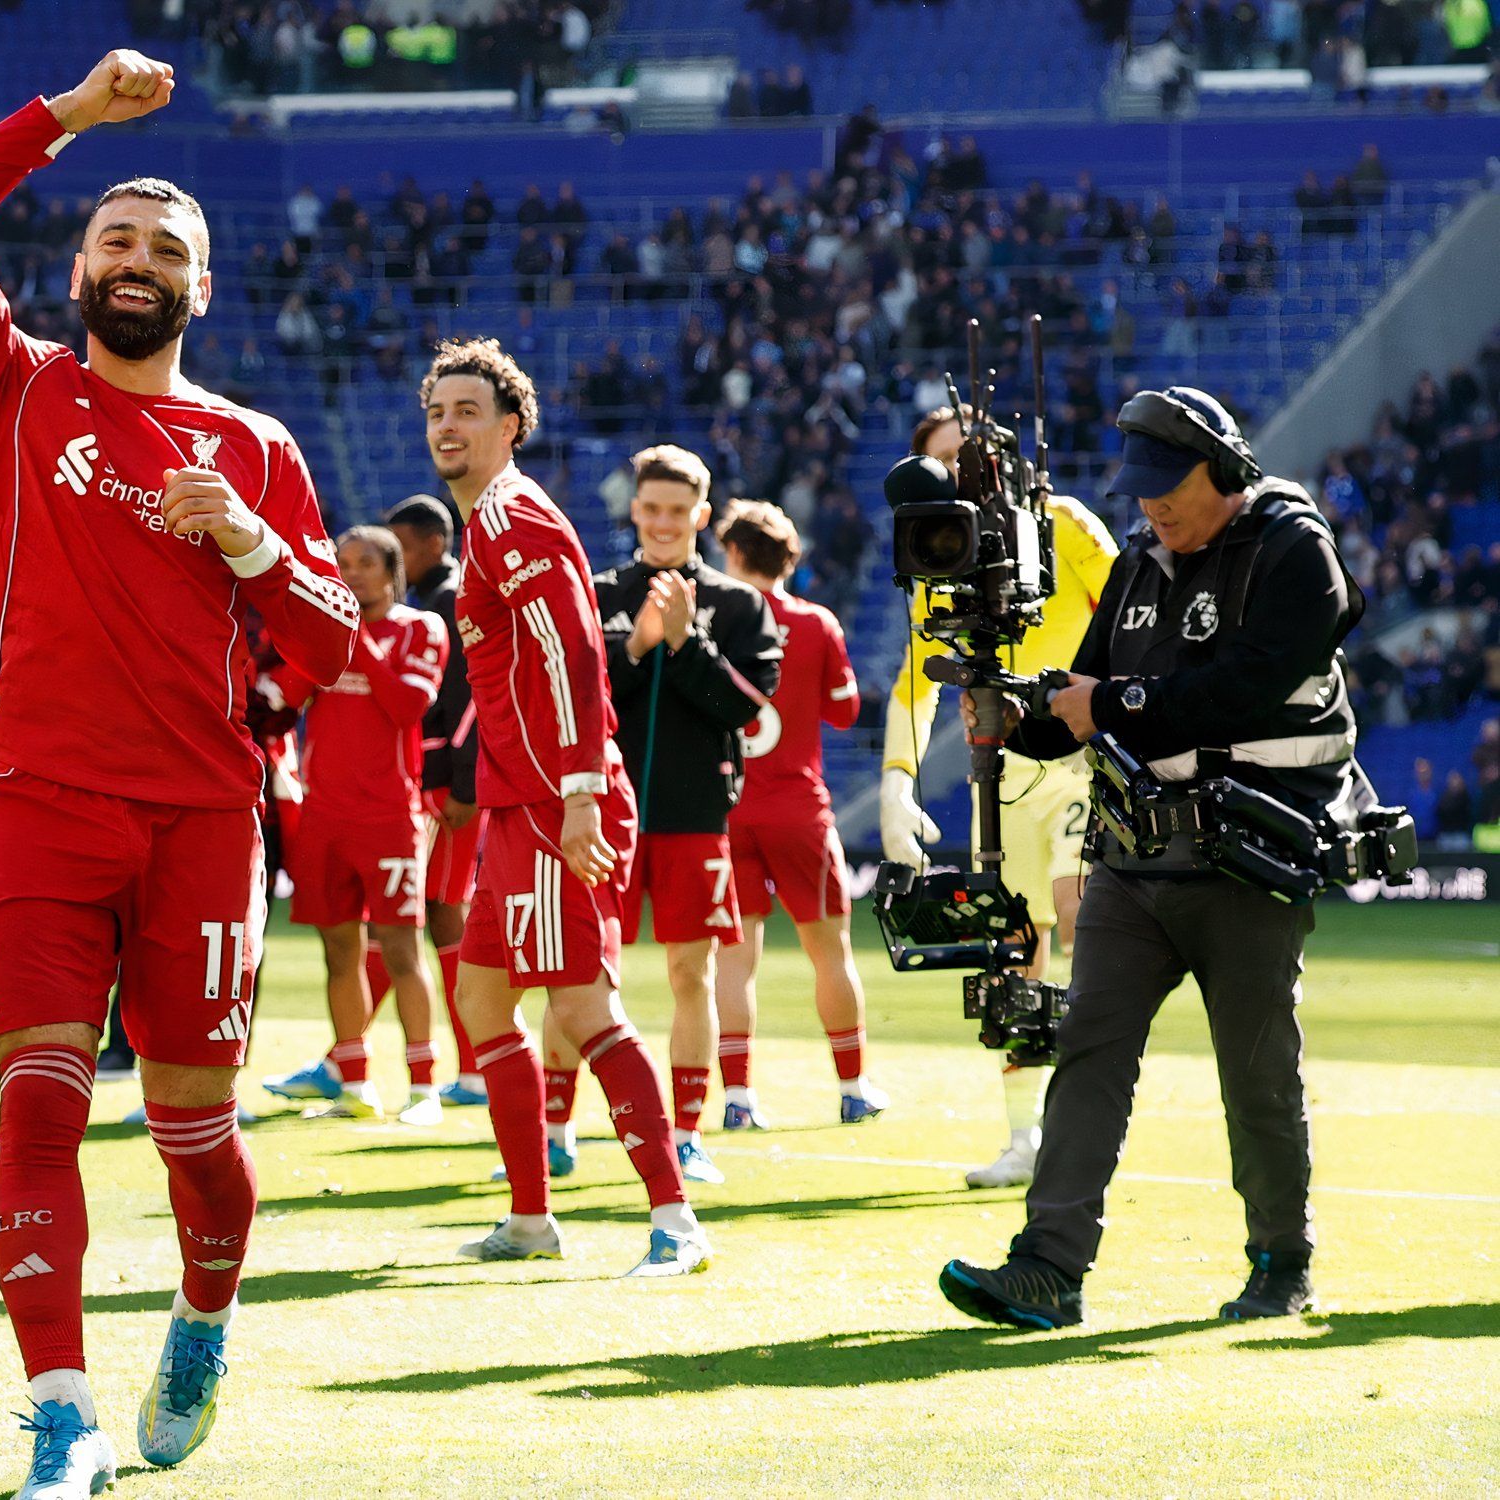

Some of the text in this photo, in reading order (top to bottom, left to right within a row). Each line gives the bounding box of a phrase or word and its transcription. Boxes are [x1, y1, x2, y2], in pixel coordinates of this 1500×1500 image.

[704, 858, 731, 904] 7
[505, 893, 535, 948] 17
[201, 921, 245, 1000] 11
[186, 1226, 240, 1247] LFC
